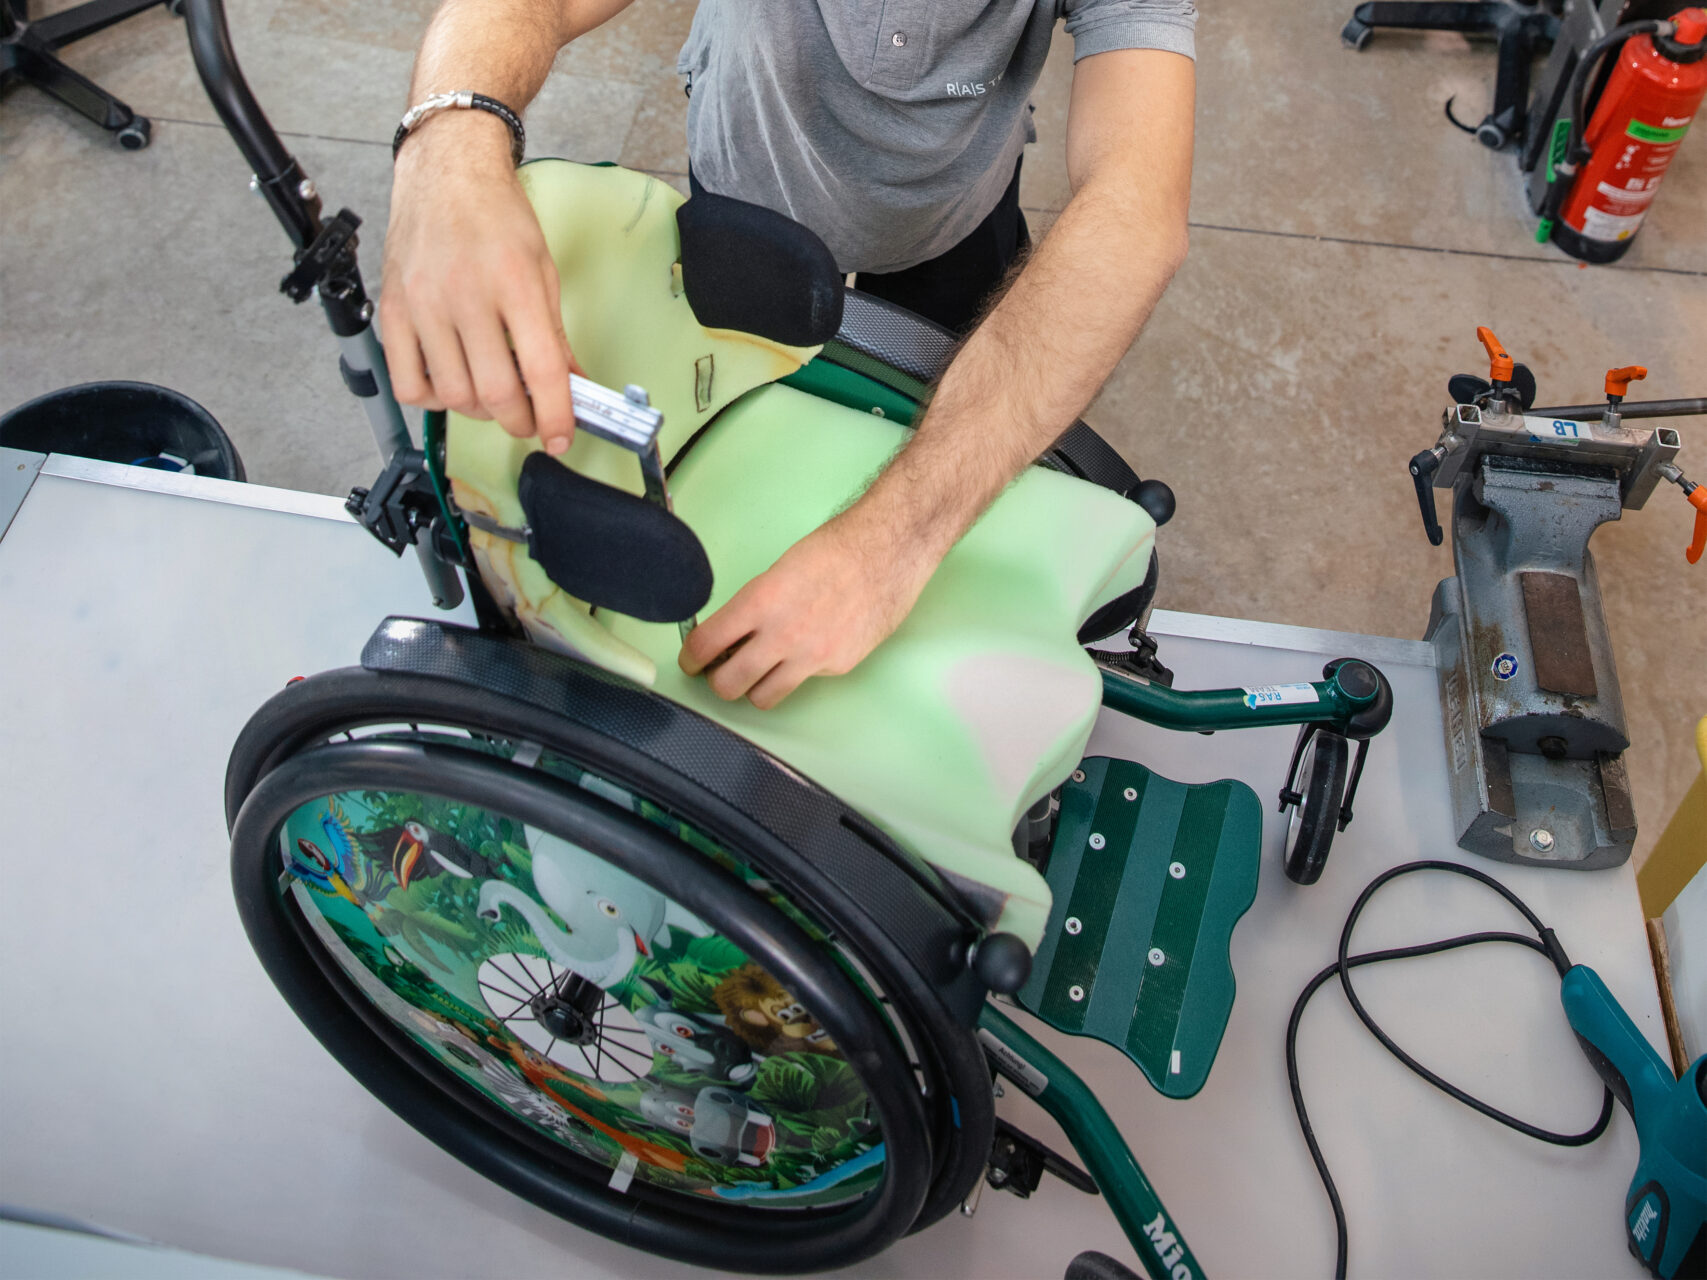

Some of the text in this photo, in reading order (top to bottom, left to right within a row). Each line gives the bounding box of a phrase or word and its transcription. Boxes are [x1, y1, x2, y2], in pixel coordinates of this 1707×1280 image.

[1552, 420, 1579, 438] LB
[1258, 692, 1283, 702] RAS
[998, 1047, 1026, 1071] Achtung!
[1142, 1211, 1192, 1280] Mio
